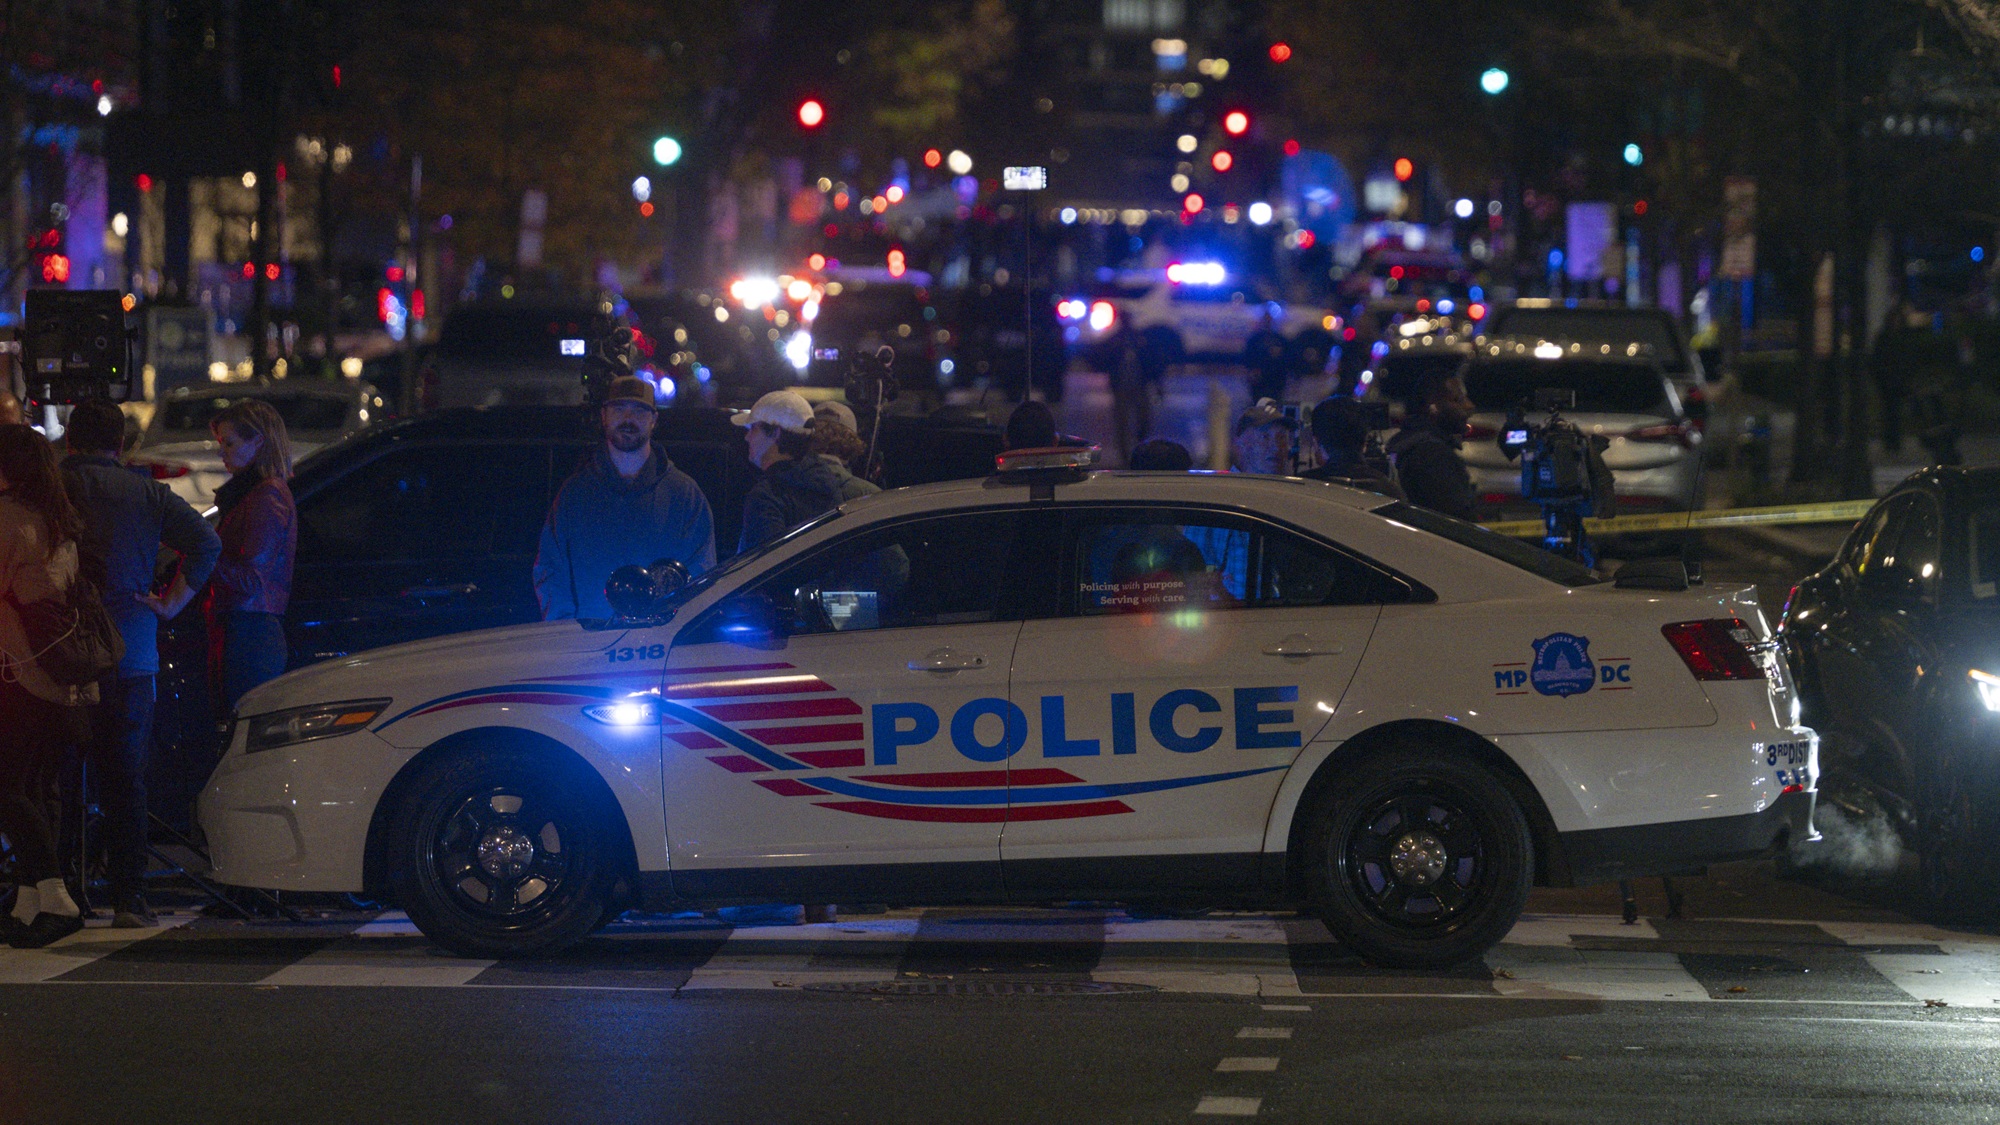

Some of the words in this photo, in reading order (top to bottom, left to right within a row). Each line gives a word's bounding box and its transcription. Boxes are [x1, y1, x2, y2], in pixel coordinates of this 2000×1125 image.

[1080, 582, 1119, 592] Policing
[1122, 581, 1140, 590] with
[1100, 595, 1139, 605] Serving
[1142, 594, 1160, 603] with
[604, 643, 665, 663] 1318
[1494, 670, 1528, 689] MP
[1600, 664, 1631, 683] DC
[872, 685, 1301, 766] POLICE
